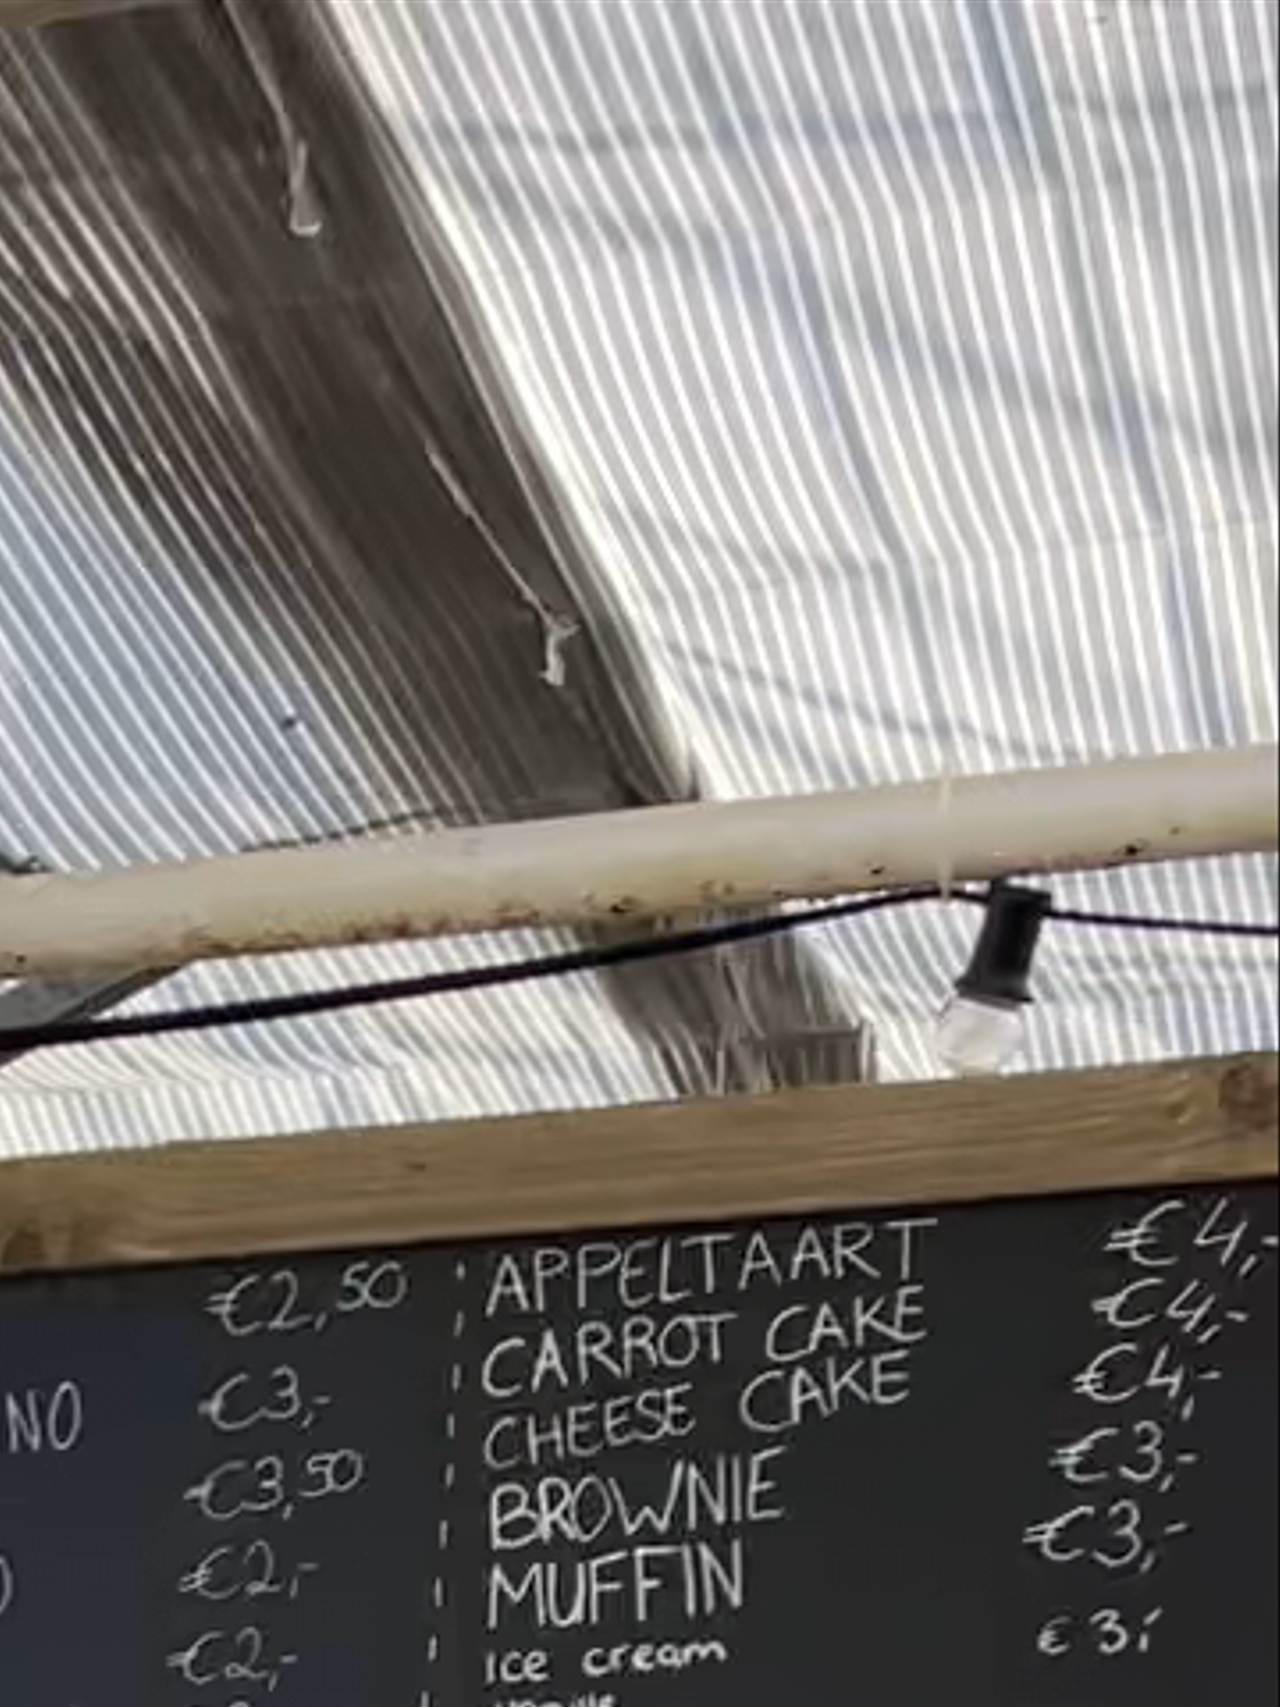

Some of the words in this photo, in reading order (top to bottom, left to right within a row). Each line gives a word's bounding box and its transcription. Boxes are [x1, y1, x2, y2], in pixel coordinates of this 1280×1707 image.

[484, 1217, 939, 1318] APPELTAART
[480, 1311, 738, 1399] CARROT
[764, 1283, 928, 1364] CAKE
[482, 1381, 697, 1470] CHEESE
[738, 1348, 910, 1434] CAKE
[488, 1444, 787, 1552] BROWNIE
[486, 1537, 744, 1631] MUFFIN
[580, 1639, 729, 1679] cream
